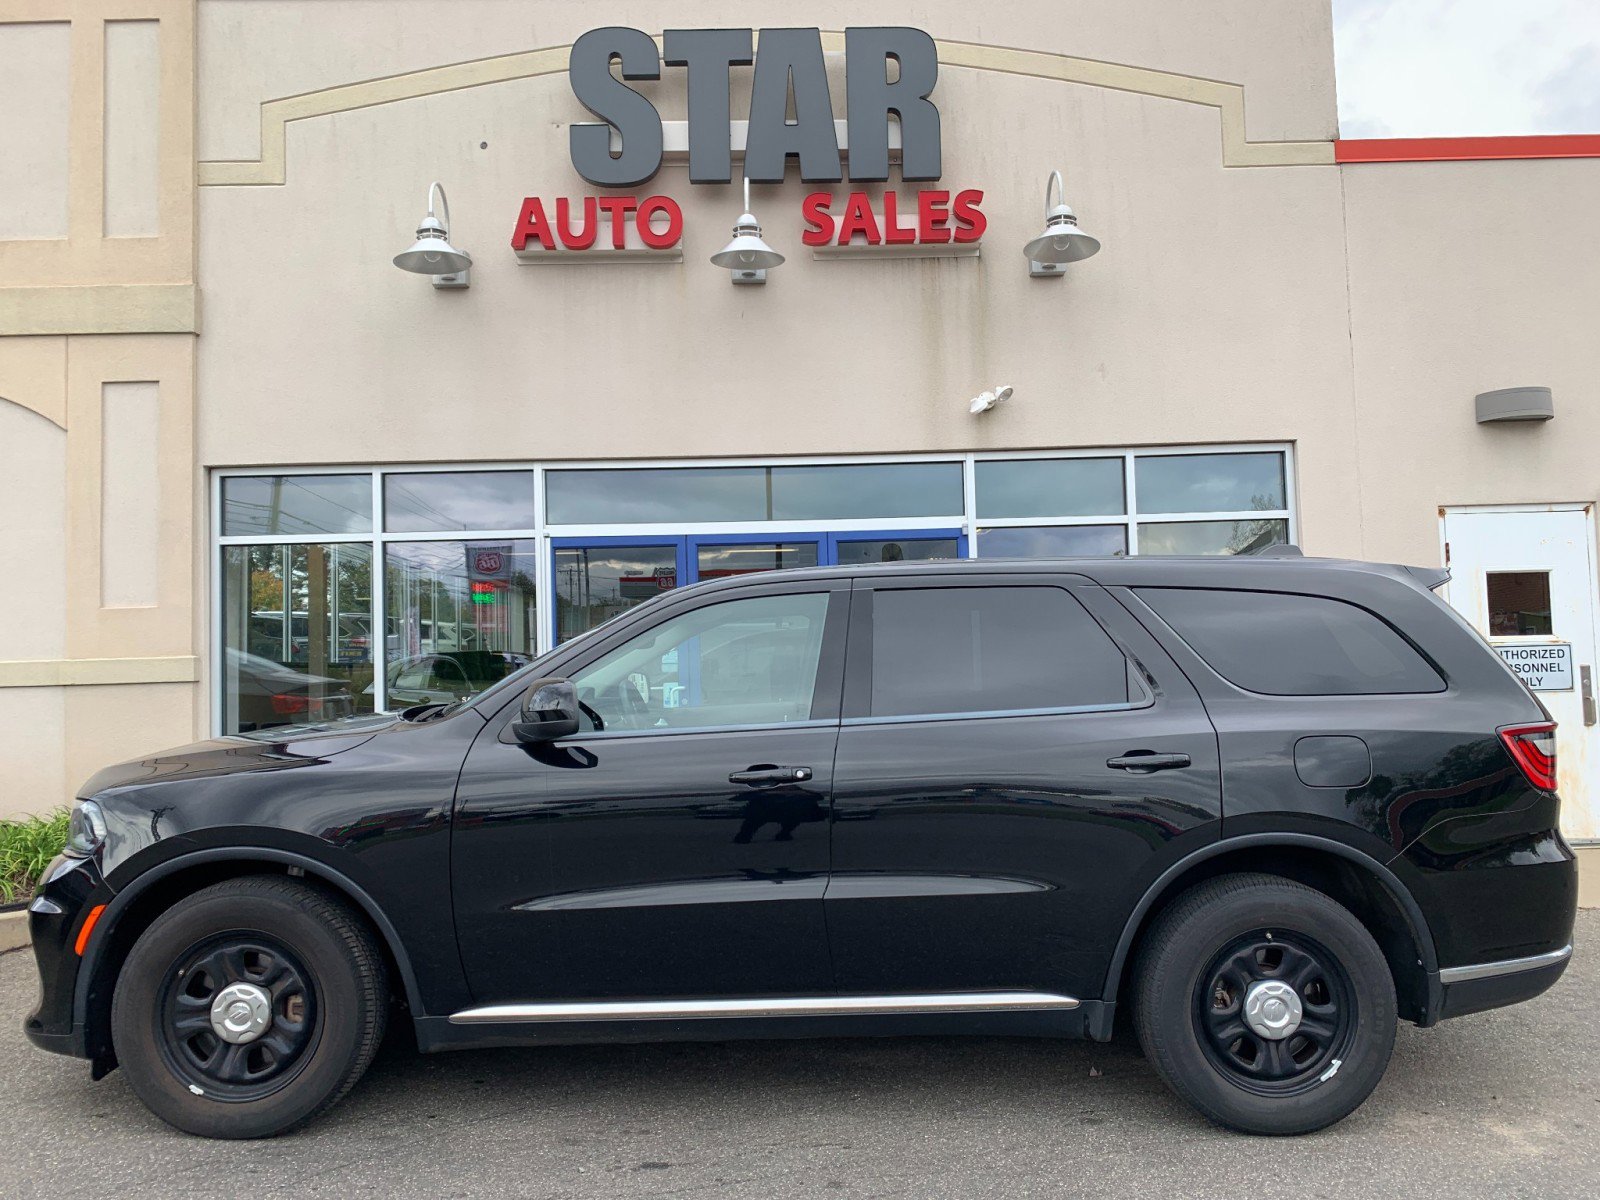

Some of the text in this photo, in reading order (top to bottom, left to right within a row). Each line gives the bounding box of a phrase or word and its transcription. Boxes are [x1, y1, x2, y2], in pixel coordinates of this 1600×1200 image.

[569, 26, 942, 189] STAR
[511, 189, 988, 251] AUTO SALES
[1500, 649, 1565, 660] THORIZED
[1509, 662, 1565, 673] SONNEL
[1520, 676, 1544, 687] NLY
